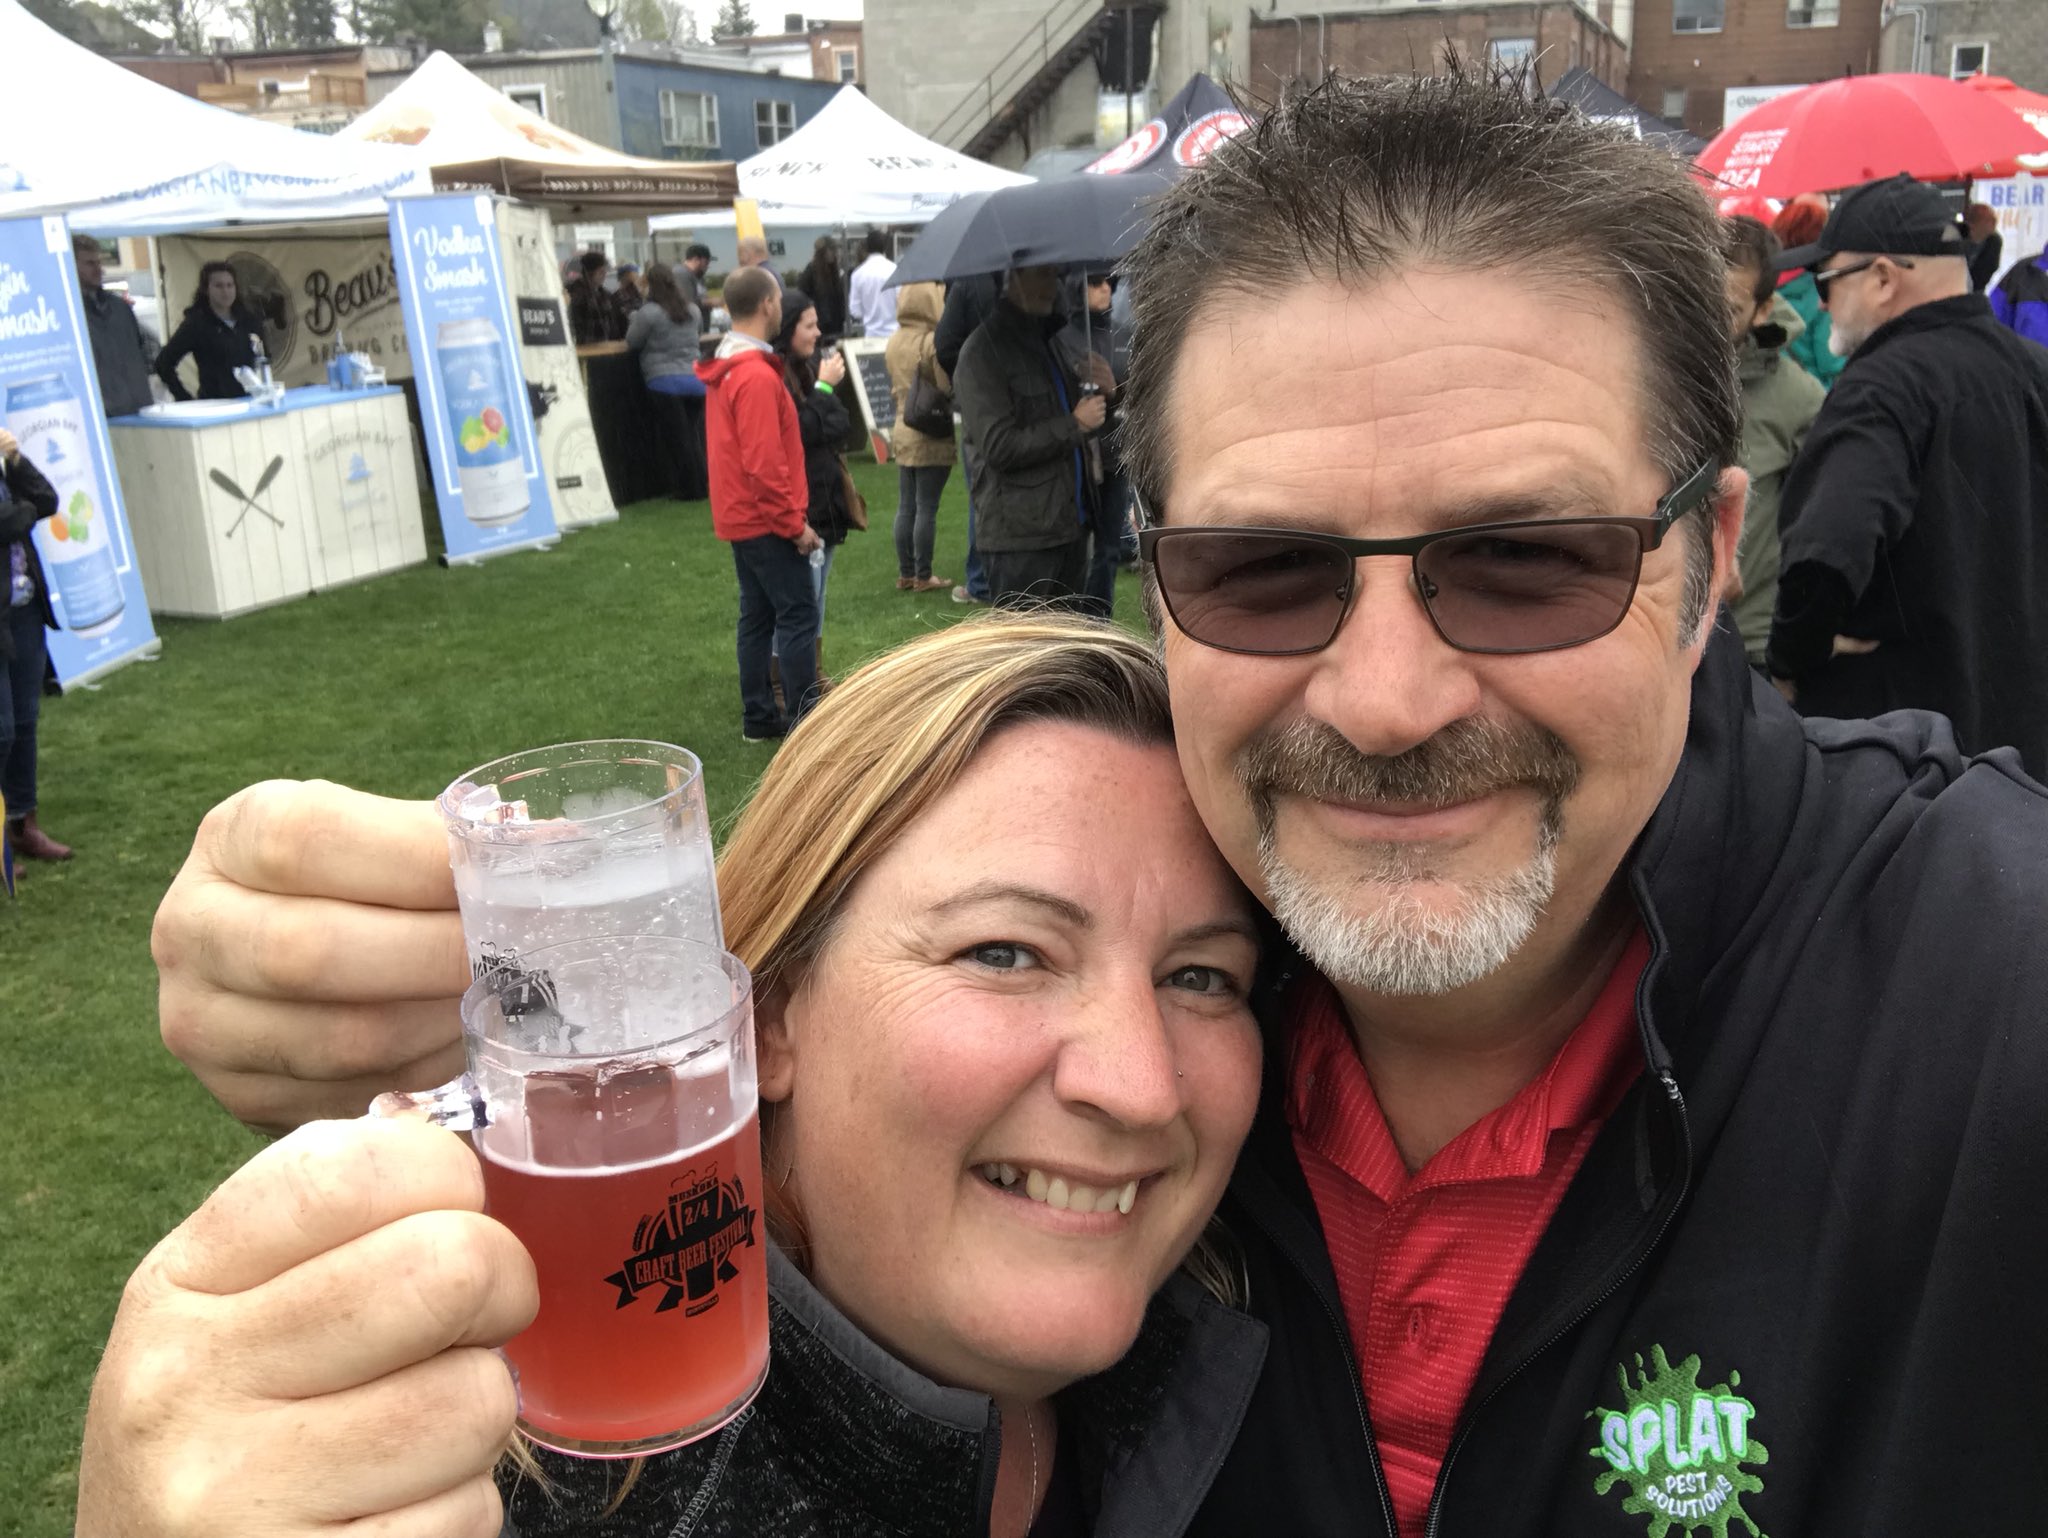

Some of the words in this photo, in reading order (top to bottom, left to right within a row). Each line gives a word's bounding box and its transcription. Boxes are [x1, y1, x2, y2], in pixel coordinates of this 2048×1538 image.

[414, 225, 485, 257] Vodka
[424, 256, 488, 293] Smash
[0, 295, 60, 340] mash
[668, 1177, 718, 1204] MUSKOKA
[685, 1200, 708, 1226] 2/4
[635, 1253, 675, 1285] CRAFT
[678, 1240, 707, 1272] BEER
[709, 1213, 748, 1259] FESTIVAL
[1602, 1393, 1755, 1474] SPLAT
[1646, 1474, 1733, 1519] SOLUTIONS
[1665, 1472, 1707, 1494] PEST
